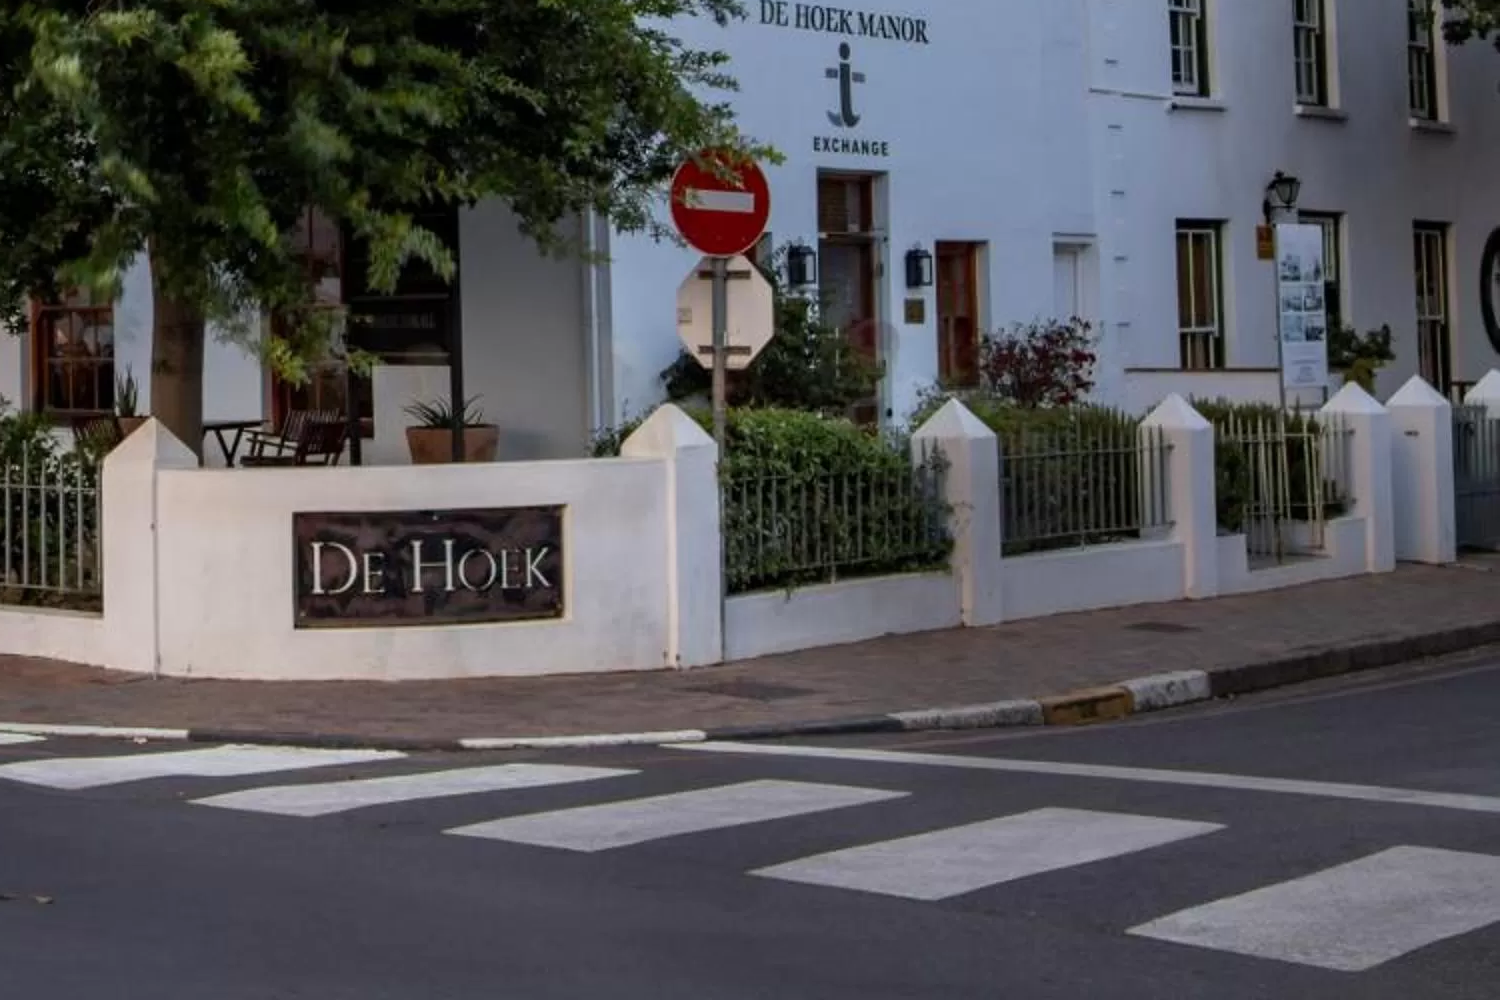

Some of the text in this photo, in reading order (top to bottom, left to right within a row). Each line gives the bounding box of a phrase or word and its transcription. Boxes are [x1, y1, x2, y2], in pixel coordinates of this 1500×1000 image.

[795, 3, 854, 35] HOEK
[857, 11, 930, 44] MANOR
[812, 135, 890, 157] EXCHANGE
[310, 538, 551, 595] DE HOEK
